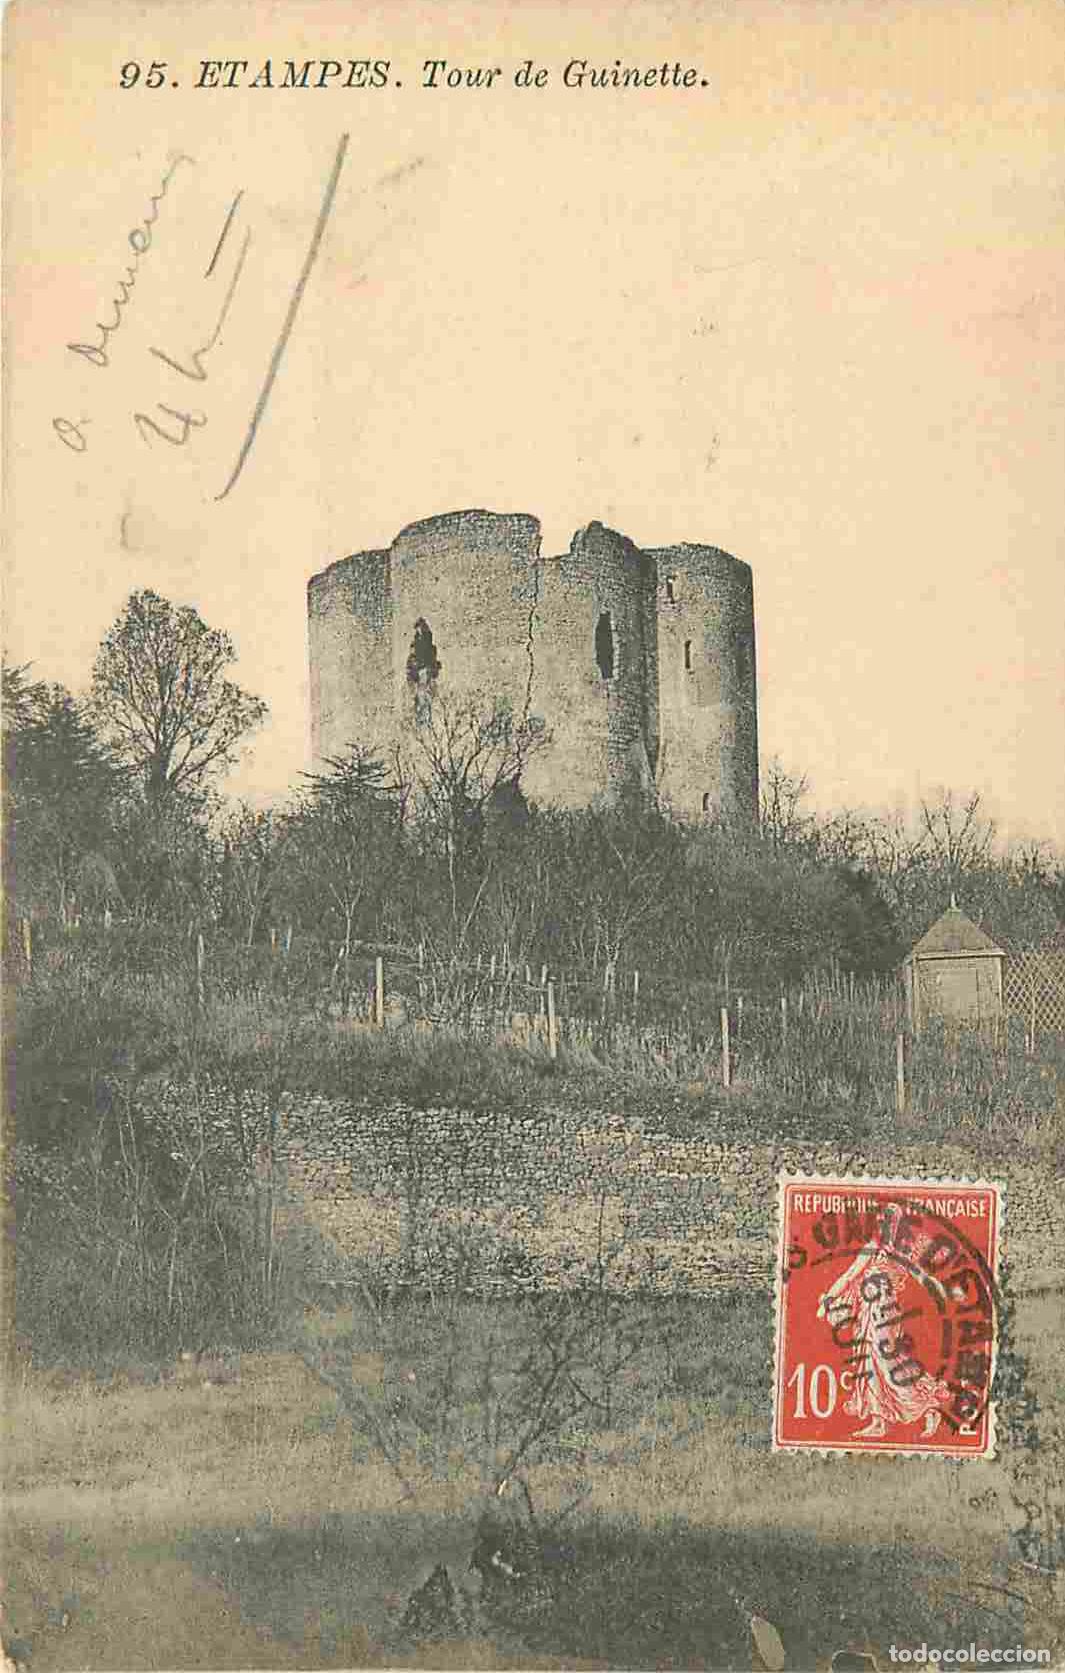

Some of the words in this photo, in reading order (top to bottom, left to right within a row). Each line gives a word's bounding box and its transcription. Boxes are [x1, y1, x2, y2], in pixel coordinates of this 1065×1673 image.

[119, 63, 180, 89] 95.
[195, 60, 403, 89] ETAMPES.
[422, 60, 502, 88] Tour
[514, 60, 549, 88] de
[563, 60, 710, 89] Guinette.
[793, 1194, 879, 1214] REPUB
